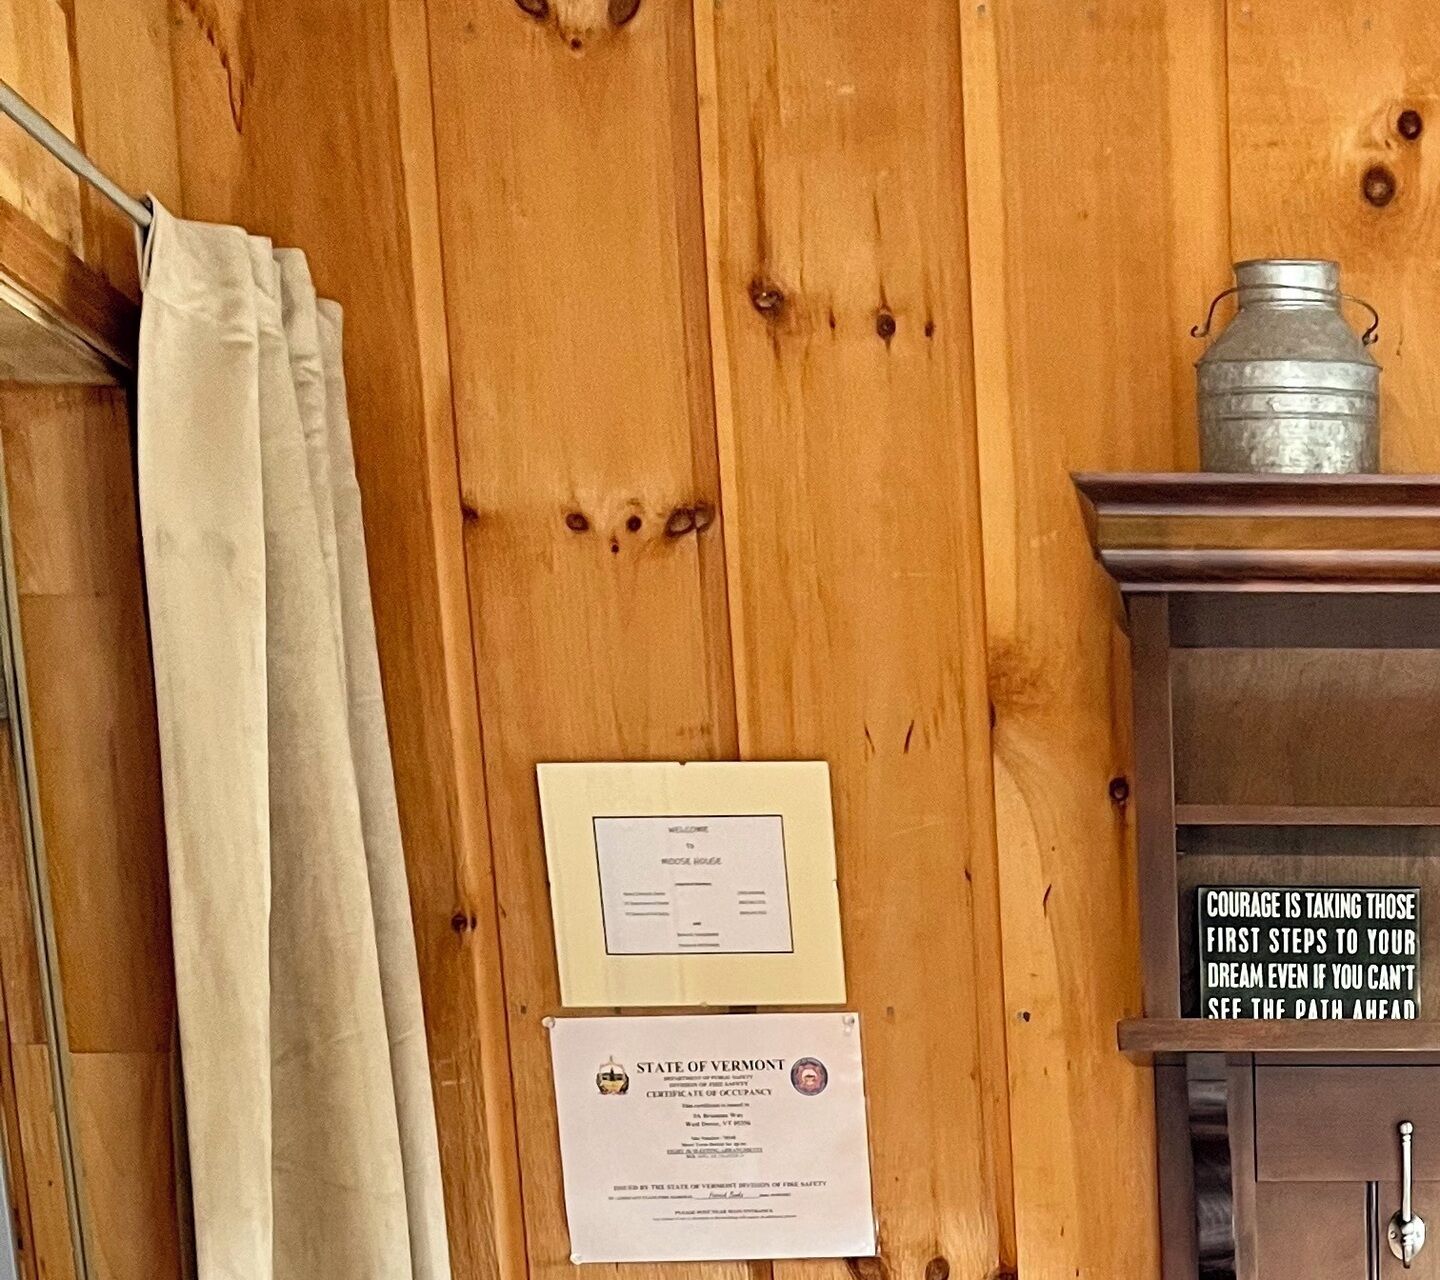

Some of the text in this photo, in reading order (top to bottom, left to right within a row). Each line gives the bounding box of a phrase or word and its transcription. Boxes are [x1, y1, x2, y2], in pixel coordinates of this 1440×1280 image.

[668, 825, 709, 833] WELCOME
[661, 857, 722, 865] MOOSE HOUSE
[1207, 891, 1415, 920] COURAGE IS TAKING THOSE
[1207, 927, 1415, 955] FIRST STEPS TO YOUR
[1207, 962, 1415, 990] DREAM EVEN IF YOU CAN'T
[1208, 997, 1415, 1020] SEE THE PATH AHEAD
[637, 1059, 785, 1074] STATE OF VERMONT
[646, 1090, 703, 1098] CERTIFICATE
[719, 1089, 772, 1097] OCCUPANCY
